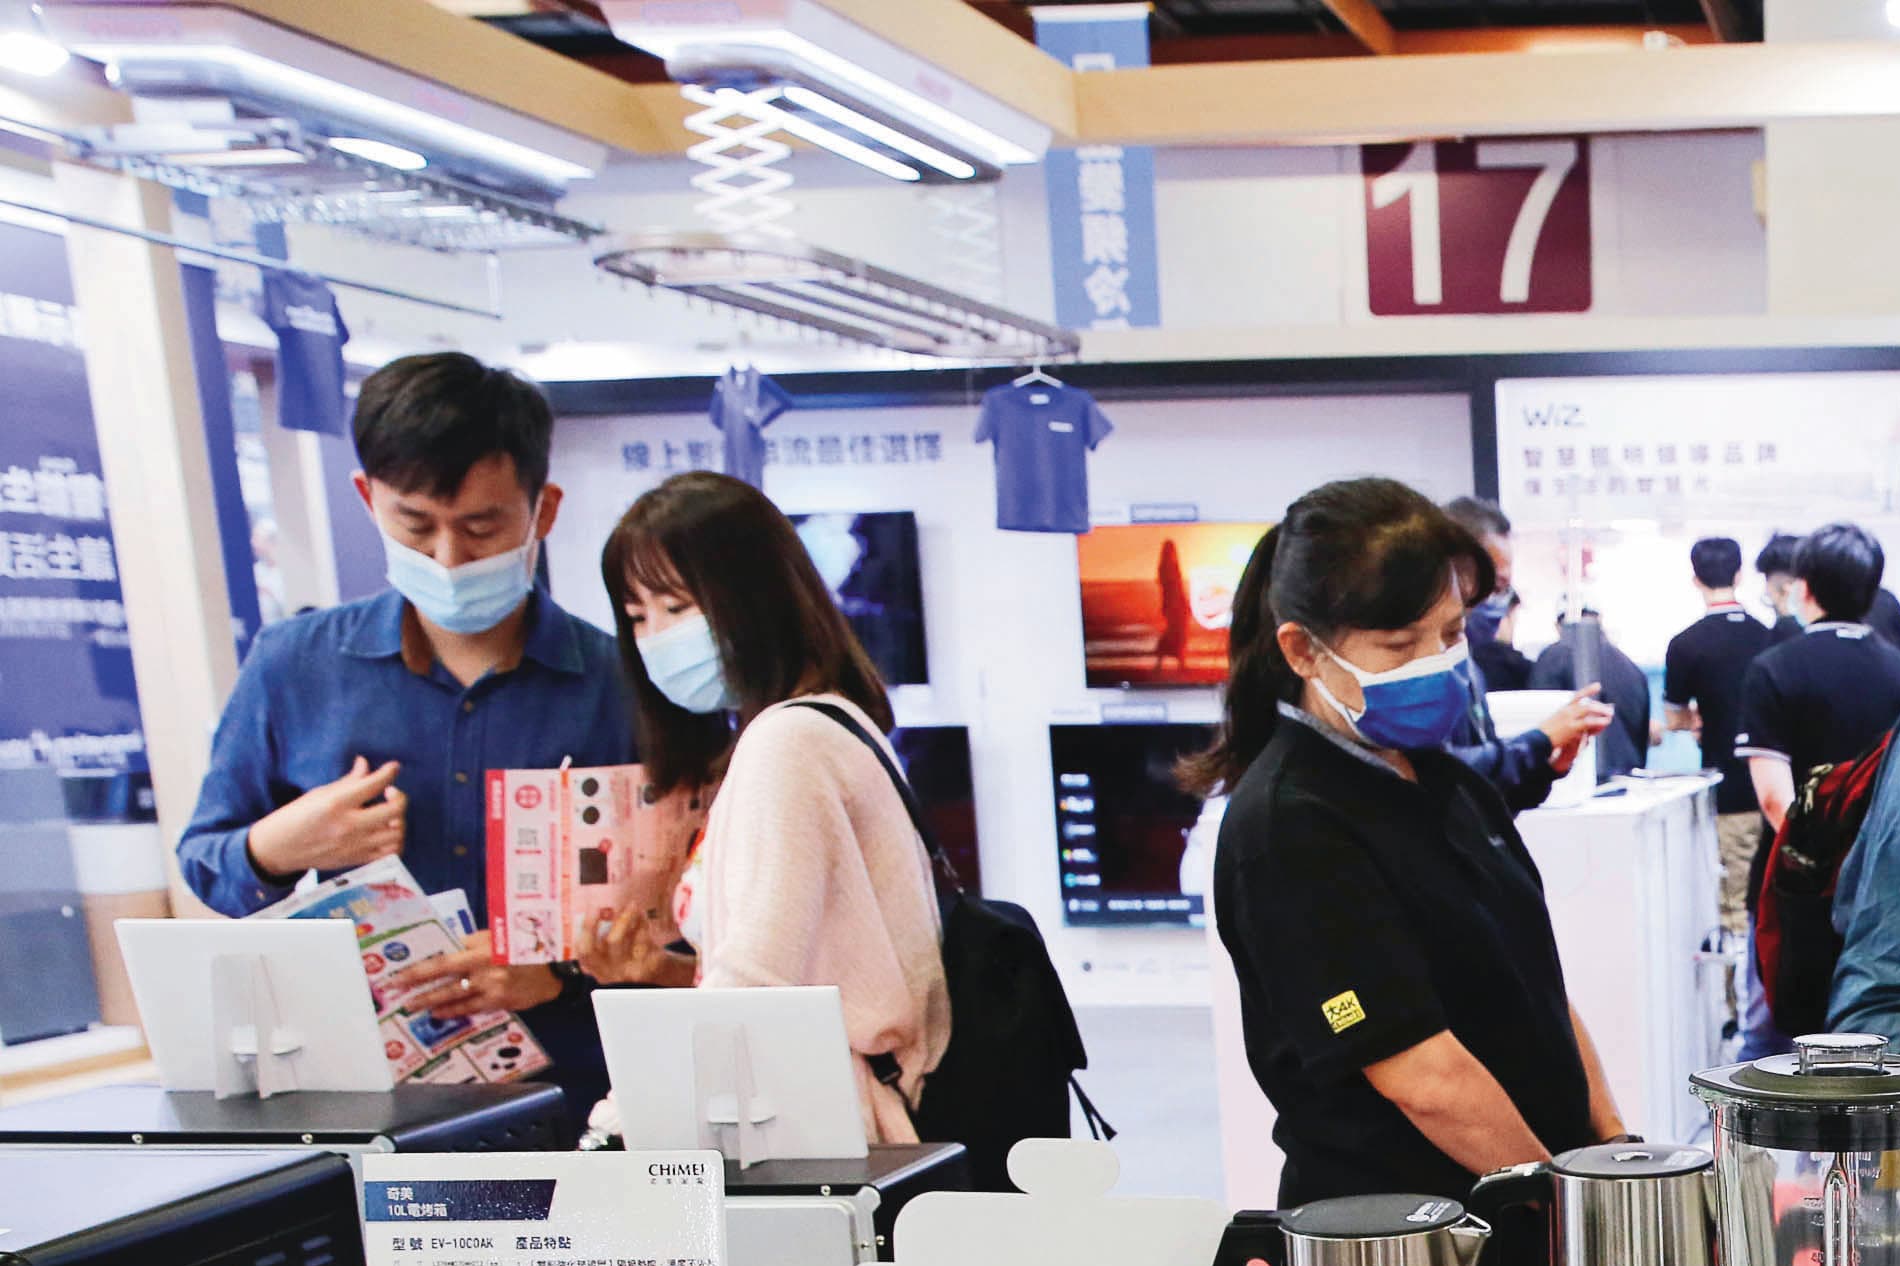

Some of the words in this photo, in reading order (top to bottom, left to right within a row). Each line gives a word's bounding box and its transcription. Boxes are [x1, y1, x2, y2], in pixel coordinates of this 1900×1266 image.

[1370, 142, 1578, 305] 17
[649, 1163, 705, 1177] CHIMEI
[386, 1187, 414, 1201] 奇美
[515, 1236, 572, 1250] 產品特點
